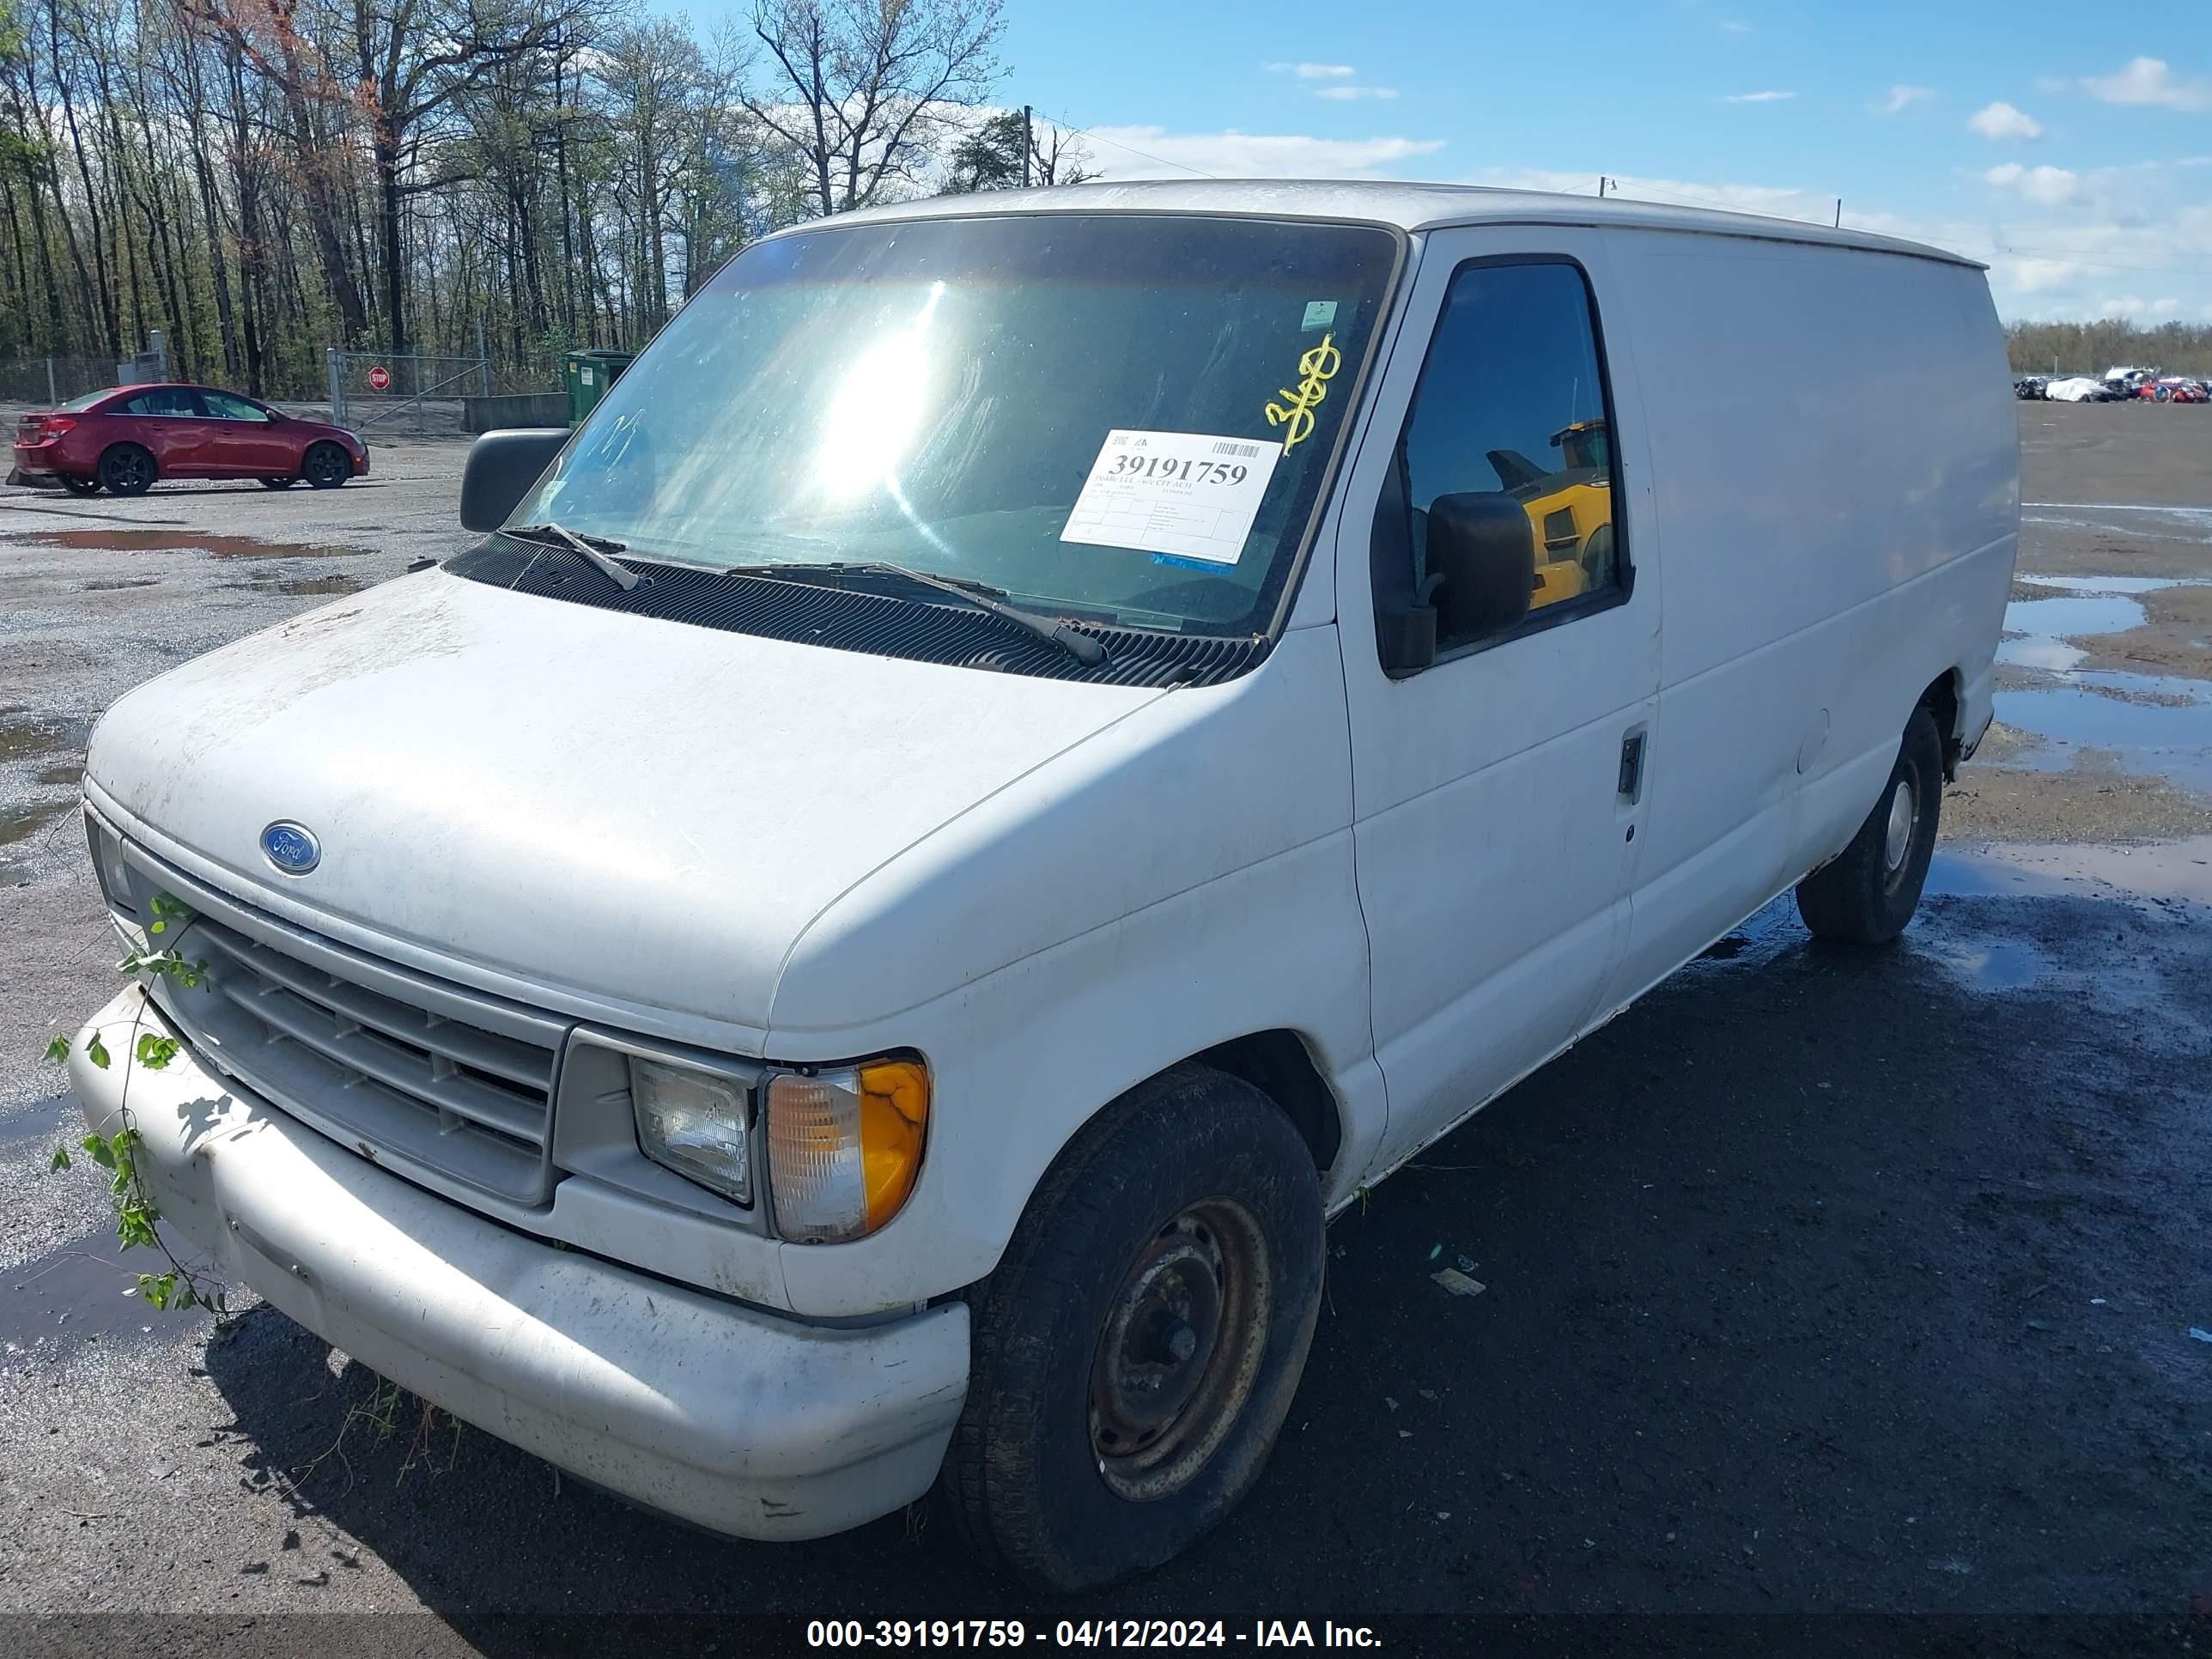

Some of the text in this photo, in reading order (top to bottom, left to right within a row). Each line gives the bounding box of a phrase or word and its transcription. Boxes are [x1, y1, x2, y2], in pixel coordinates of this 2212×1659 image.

[372, 374, 387, 383] STOP
[1108, 453, 1249, 488] 39191759
[273, 831, 305, 860] Ford
